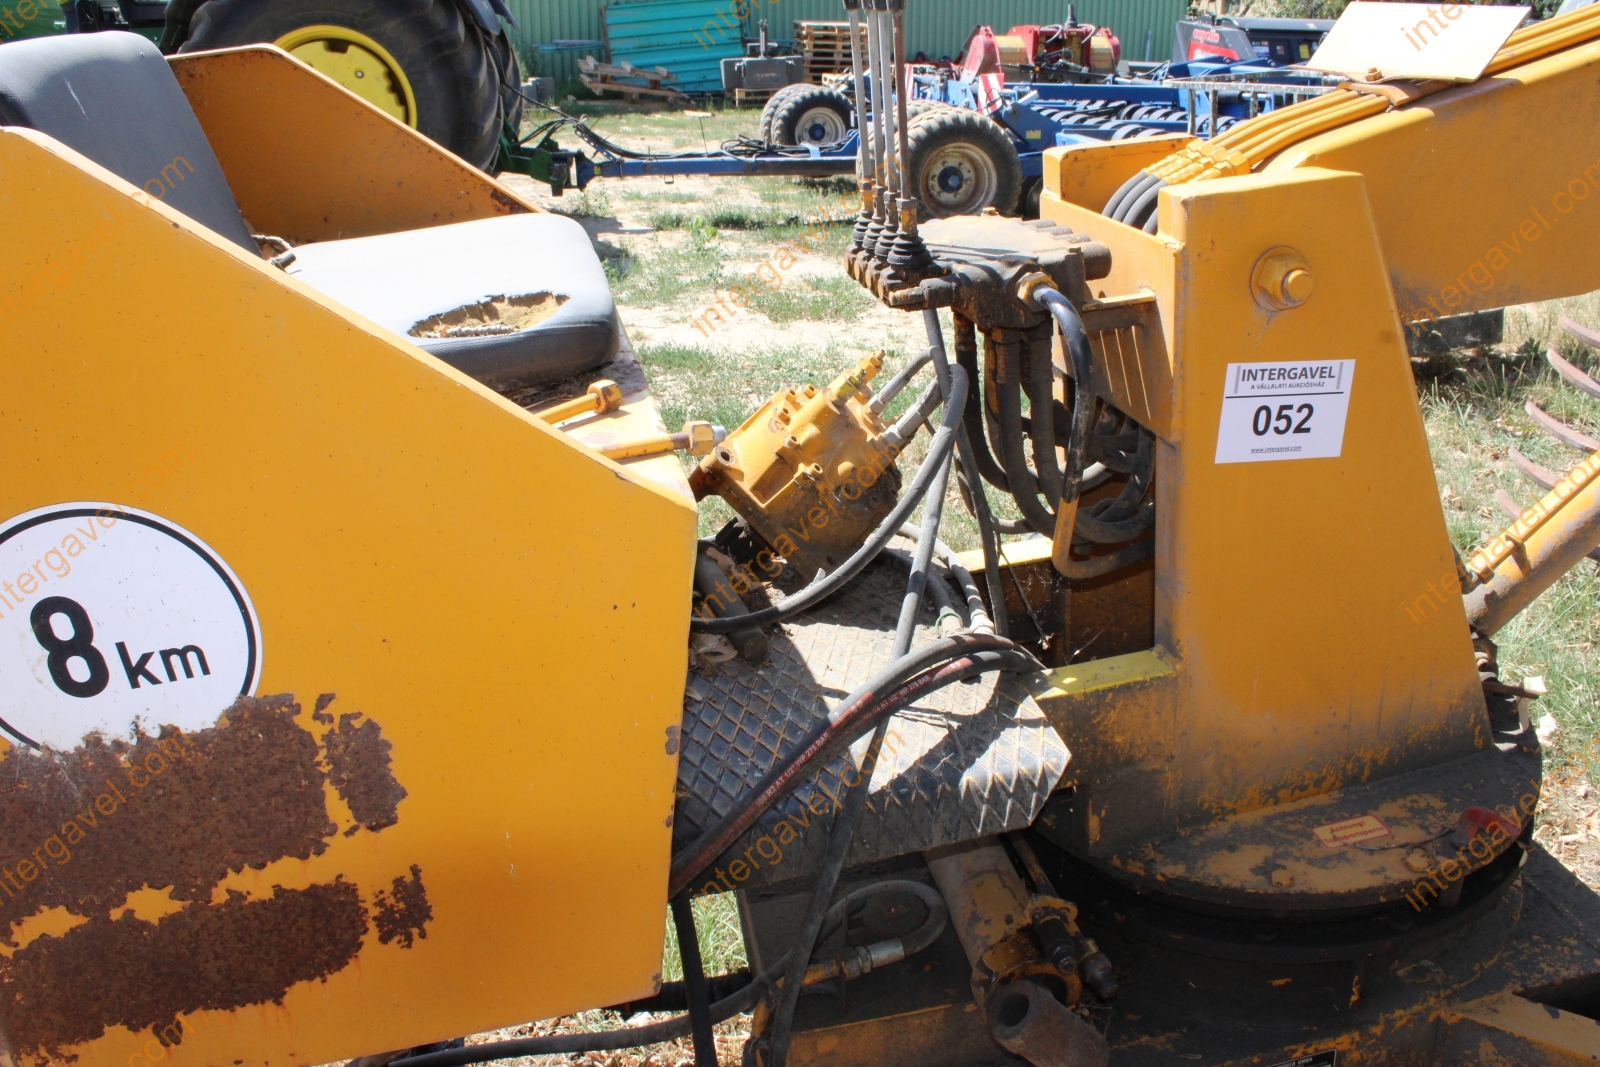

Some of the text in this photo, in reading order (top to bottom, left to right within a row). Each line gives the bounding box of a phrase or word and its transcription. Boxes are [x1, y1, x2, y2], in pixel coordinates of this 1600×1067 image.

[1241, 366, 1335, 381] INTERGAVEL
[1256, 382, 1287, 390] VÁLLALATI
[1252, 403, 1314, 436] 052
[1250, 445, 1302, 453] www.intergavel.com
[30, 595, 211, 698] 8 km
[879, 699, 889, 709] AT
[897, 685, 909, 696] WP
[906, 679, 919, 691] 275
[916, 673, 931, 685] BAR
[754, 793, 768, 808] 100
[764, 784, 777, 797] R2
[773, 776, 785, 788] AT
[793, 753, 808, 767] WP
[804, 743, 817, 757] 275
[814, 731, 830, 746] BAR
[1329, 820, 1367, 834] Achtung!
